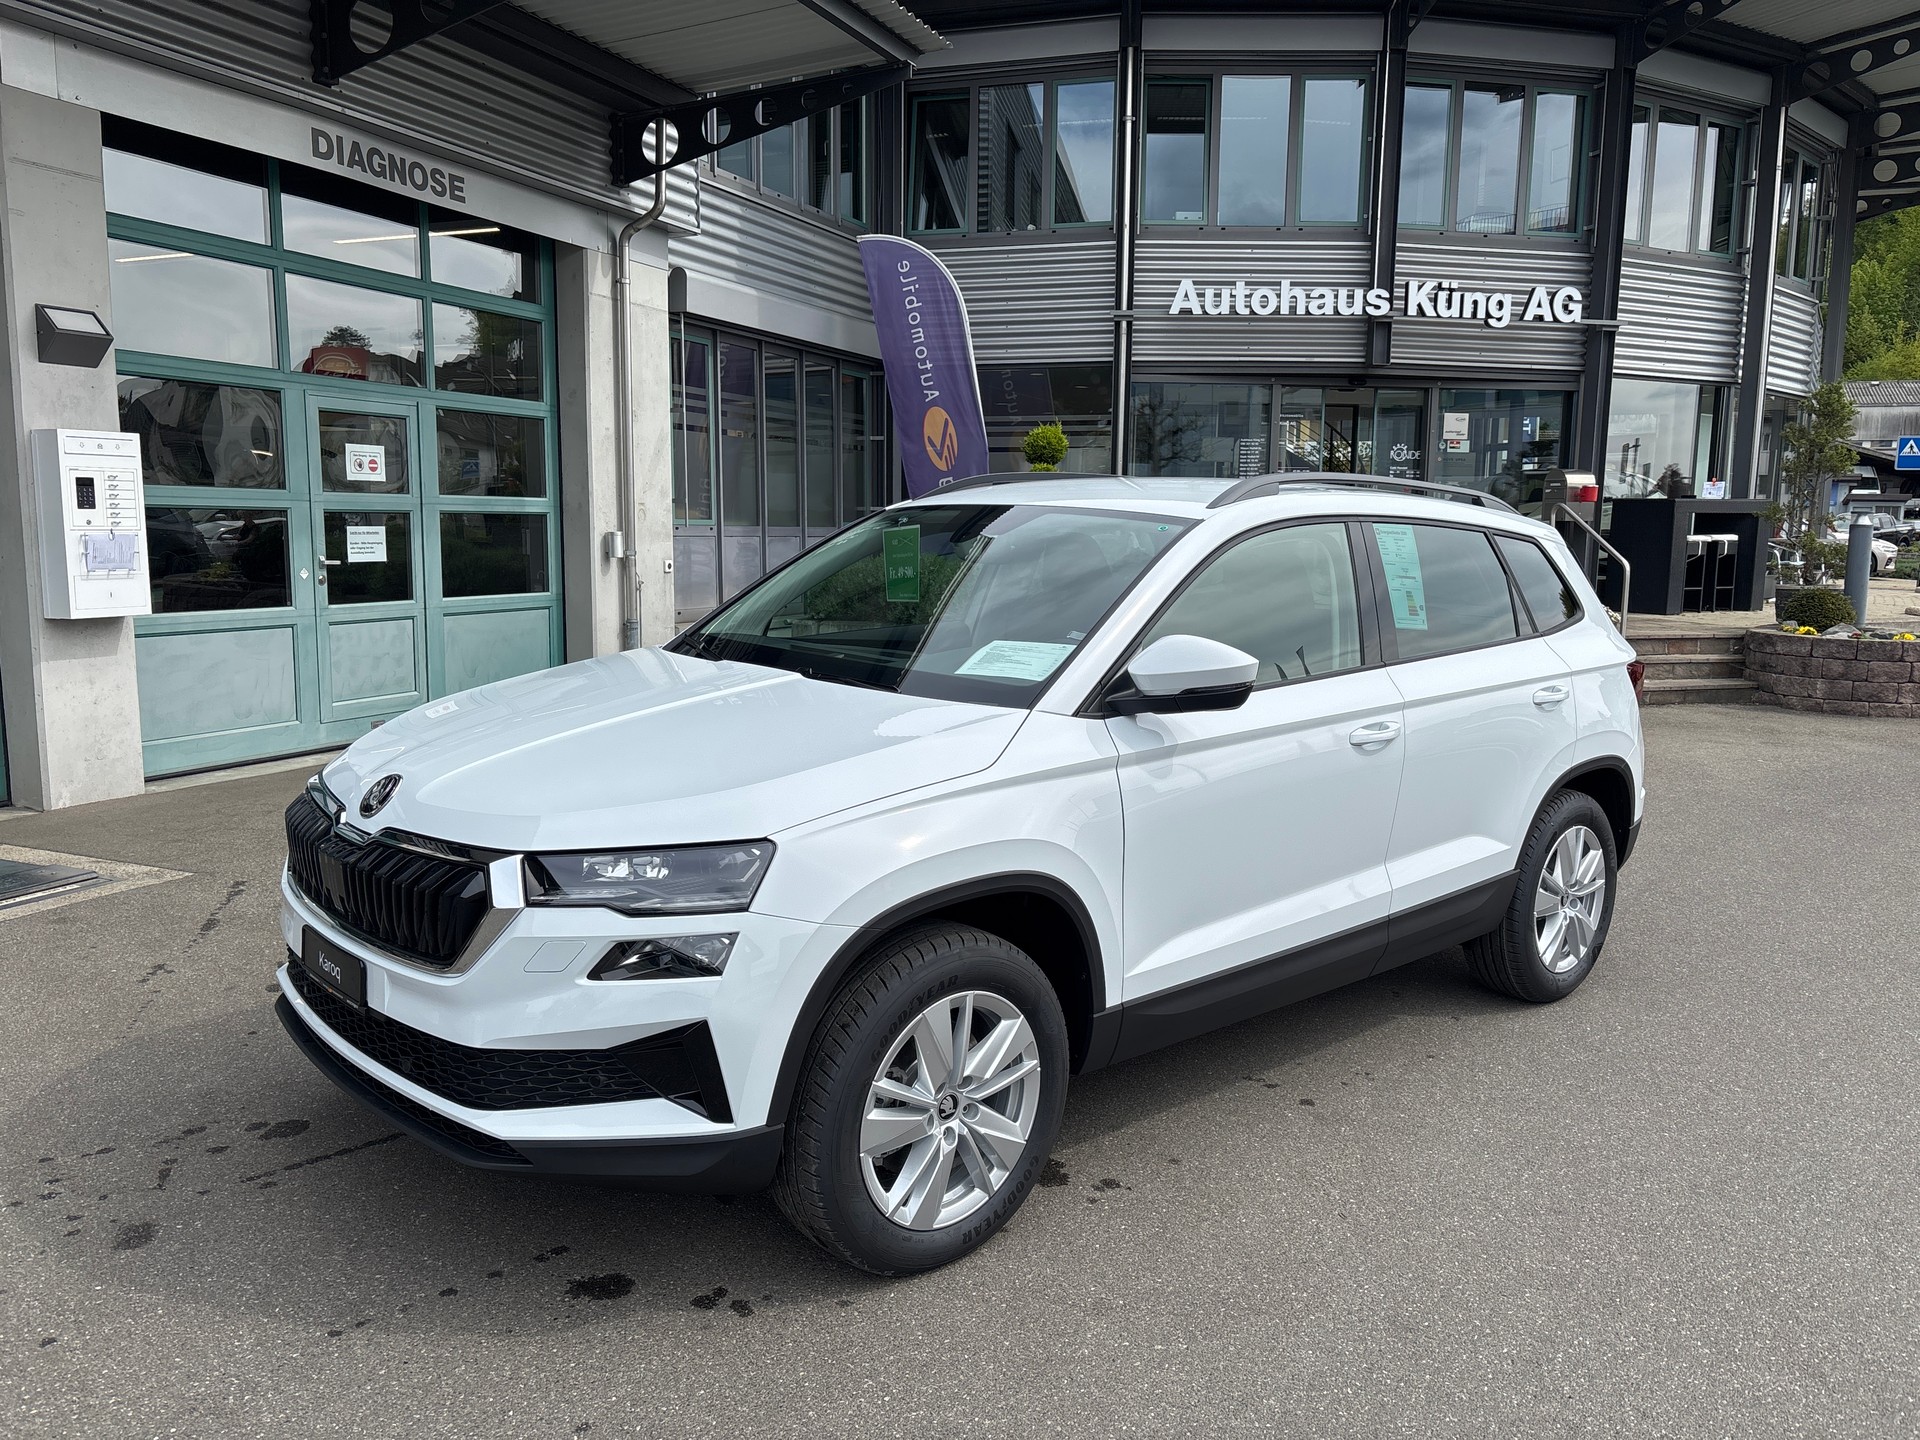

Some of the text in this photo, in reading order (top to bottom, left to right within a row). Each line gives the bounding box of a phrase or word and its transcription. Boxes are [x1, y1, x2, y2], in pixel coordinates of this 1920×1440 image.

[311, 127, 466, 204] DIAGNOSE
[1167, 279, 1583, 329] Autohaus Küng AG
[318, 950, 340, 984] Karoq
